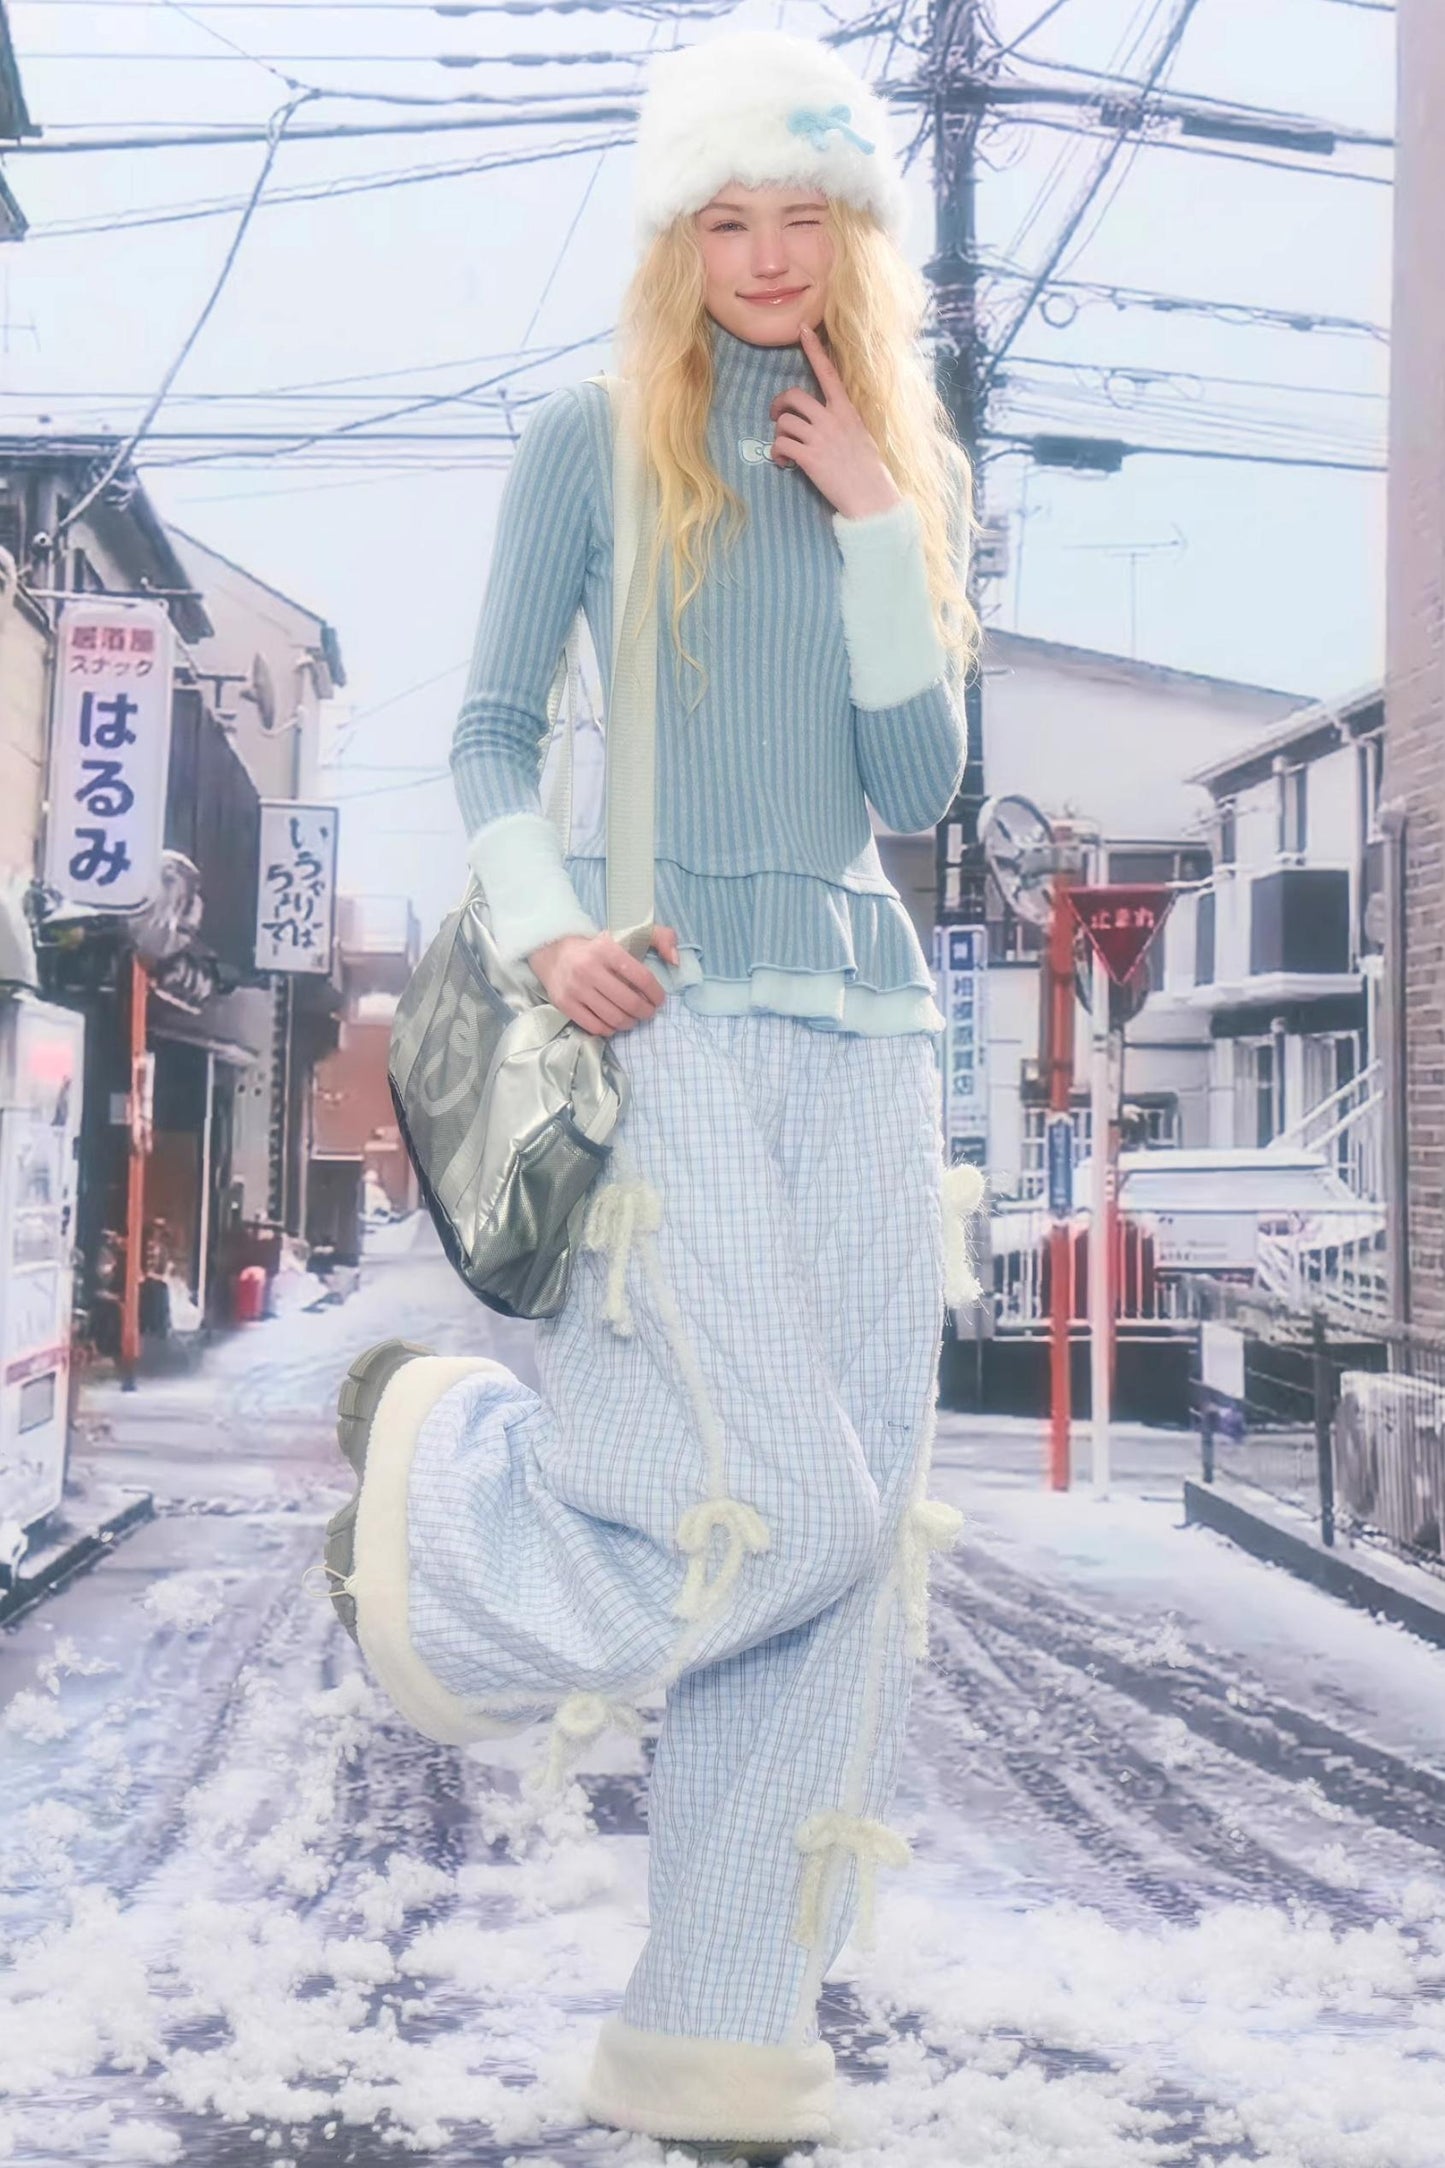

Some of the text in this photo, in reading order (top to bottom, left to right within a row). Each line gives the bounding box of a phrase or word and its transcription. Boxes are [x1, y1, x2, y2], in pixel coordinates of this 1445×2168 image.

[70, 655, 153, 678] スナック
[69, 690, 139, 887] はるみ
